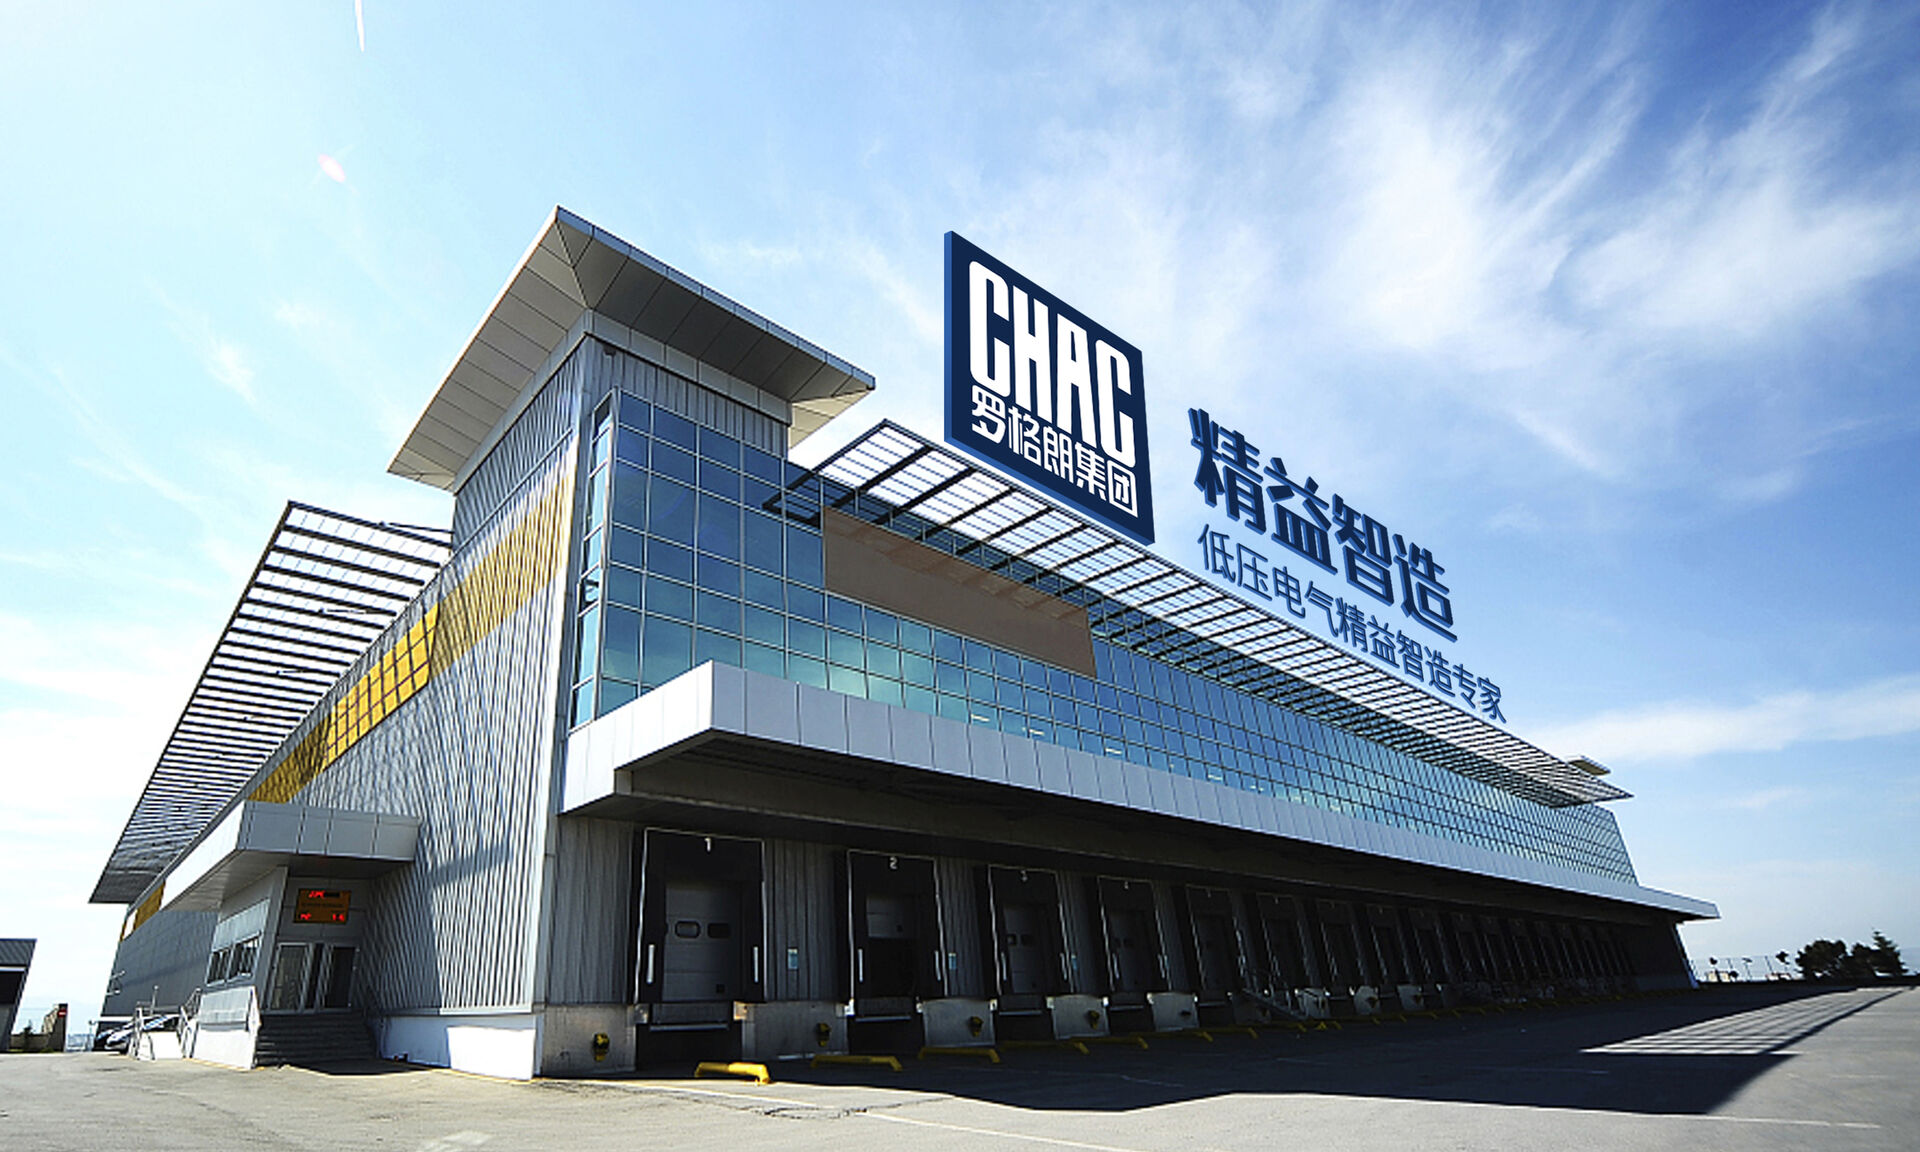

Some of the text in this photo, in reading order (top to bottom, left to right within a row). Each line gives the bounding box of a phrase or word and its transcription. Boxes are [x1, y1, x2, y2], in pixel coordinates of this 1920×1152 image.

[969, 260, 1136, 468] CHAC
[971, 384, 1139, 518] 罗格朗集团
[1188, 407, 1458, 643] 精益智造
[1197, 523, 1507, 724] 低压电气精益智造专家
[704, 837, 712, 852] 1
[889, 856, 898, 870] 2
